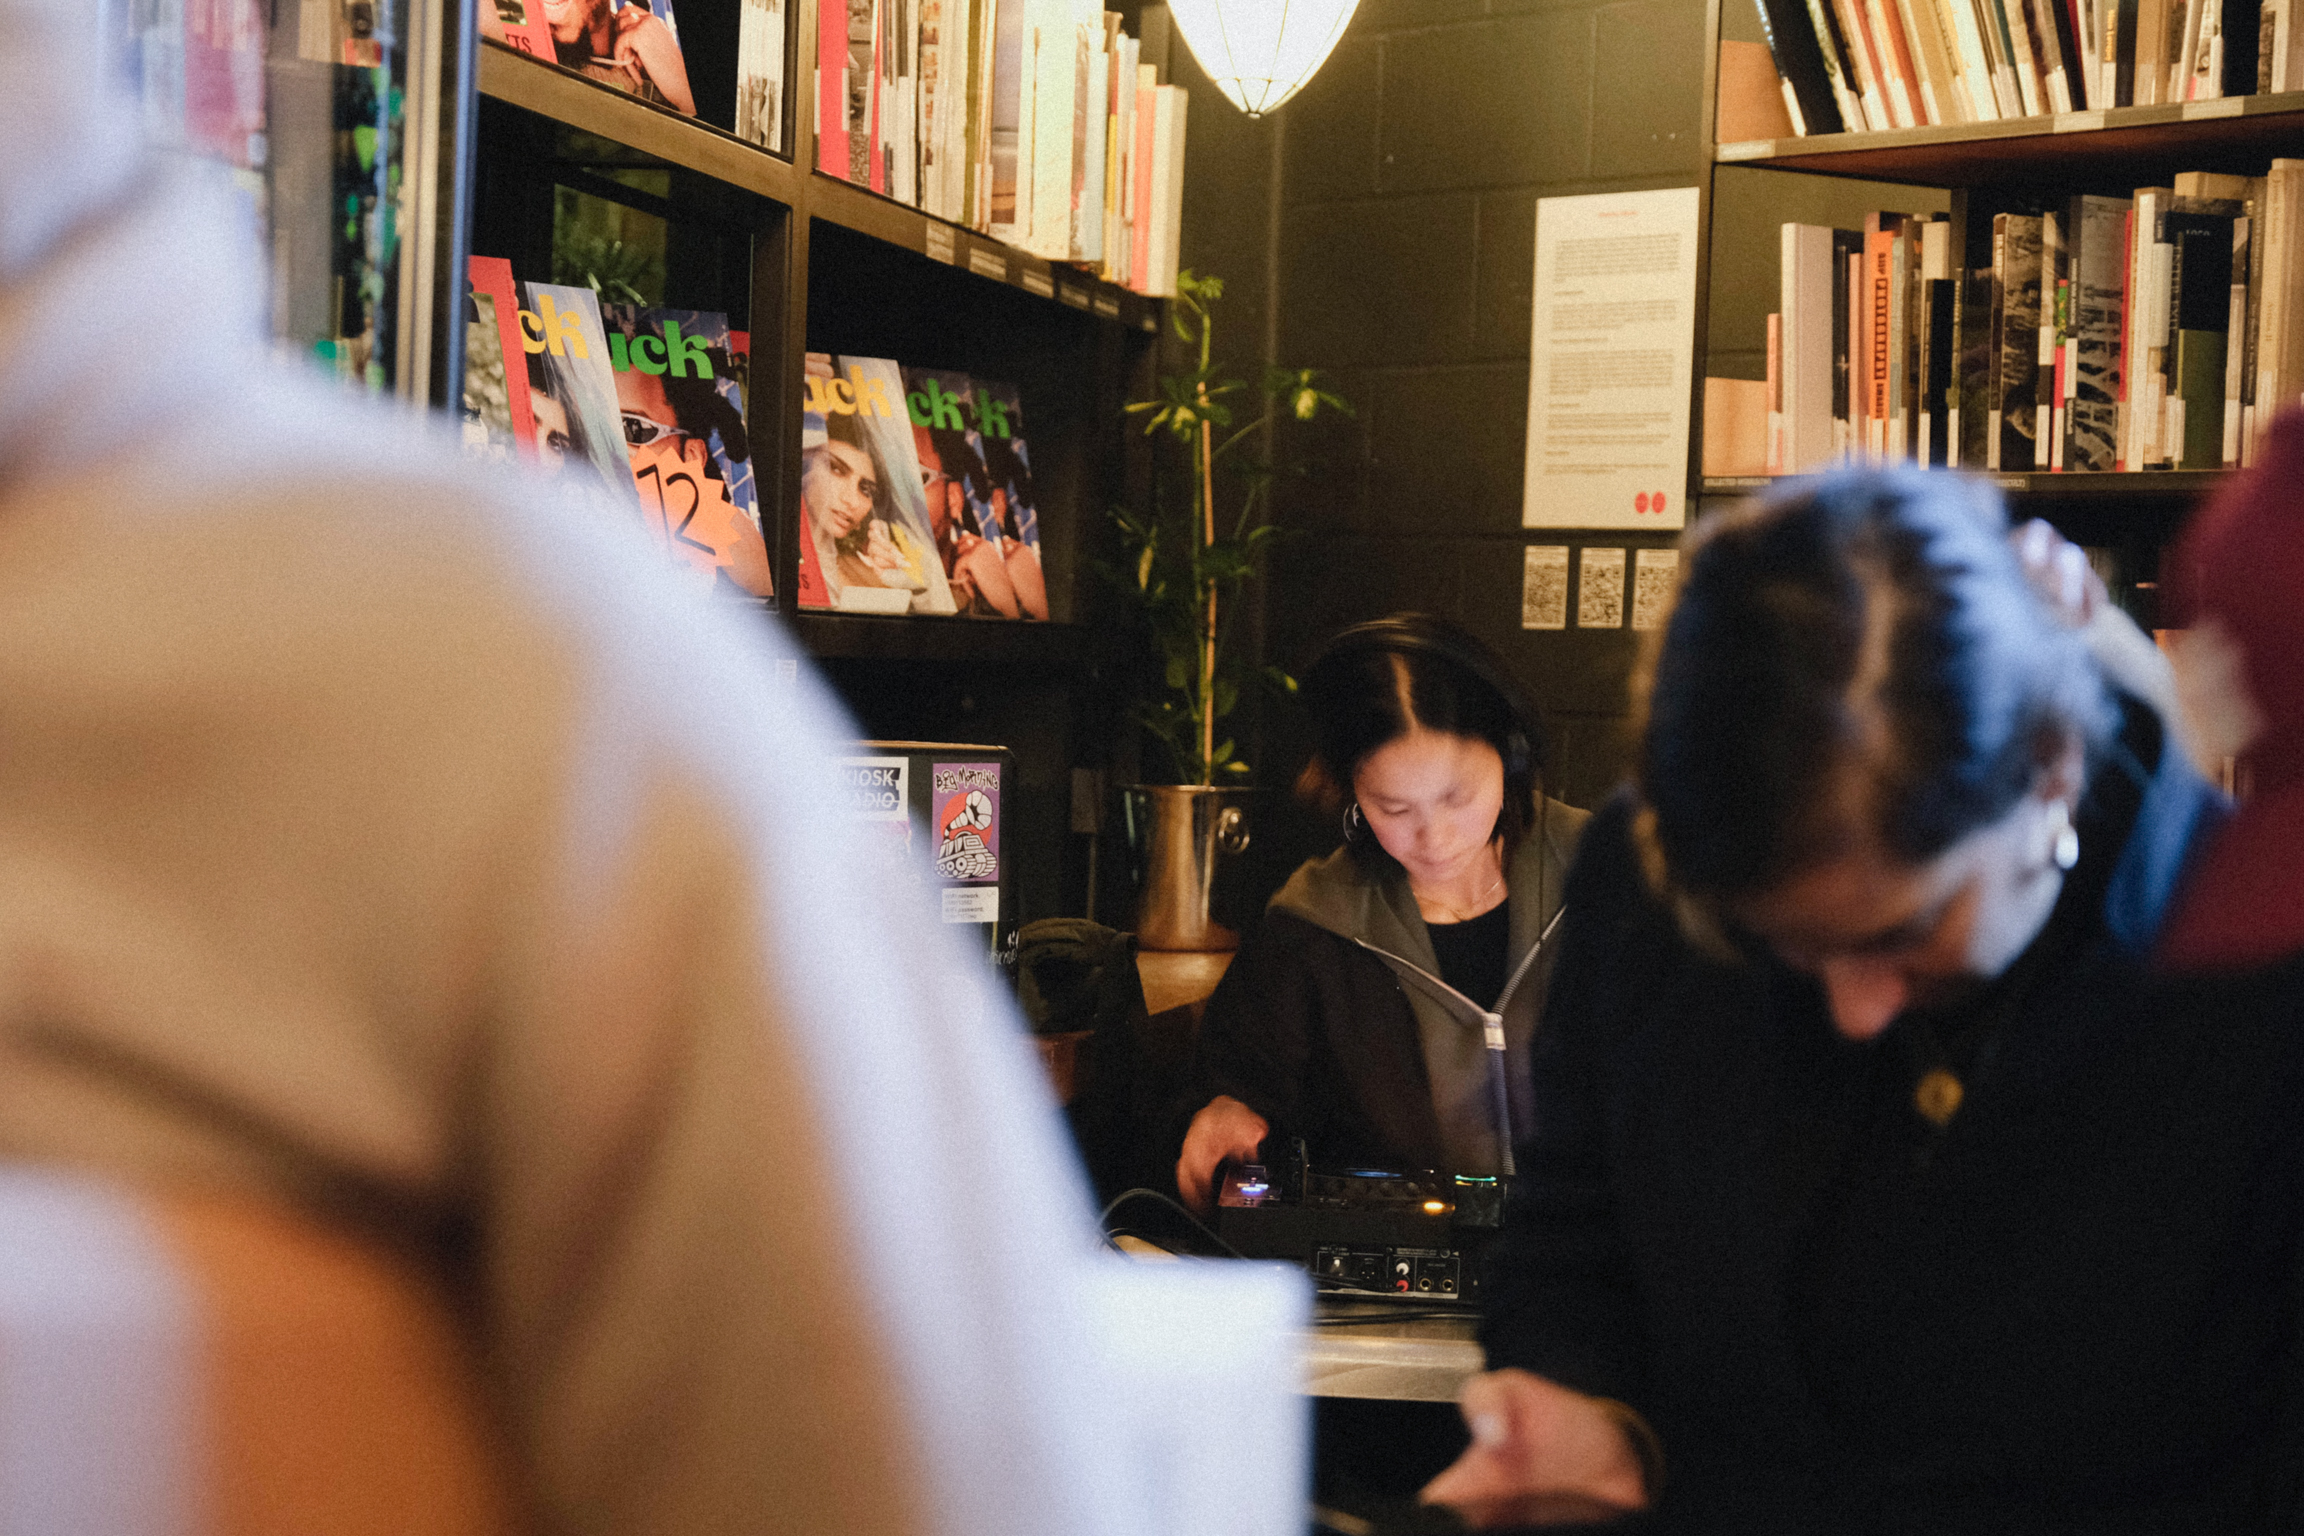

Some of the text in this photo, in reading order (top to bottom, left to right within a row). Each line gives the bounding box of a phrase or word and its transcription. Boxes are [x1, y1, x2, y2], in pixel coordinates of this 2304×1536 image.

[1874, 278, 1888, 380] PHOTOGRAPHY
[636, 463, 717, 560] 12
[841, 769, 894, 786] KIOSK
